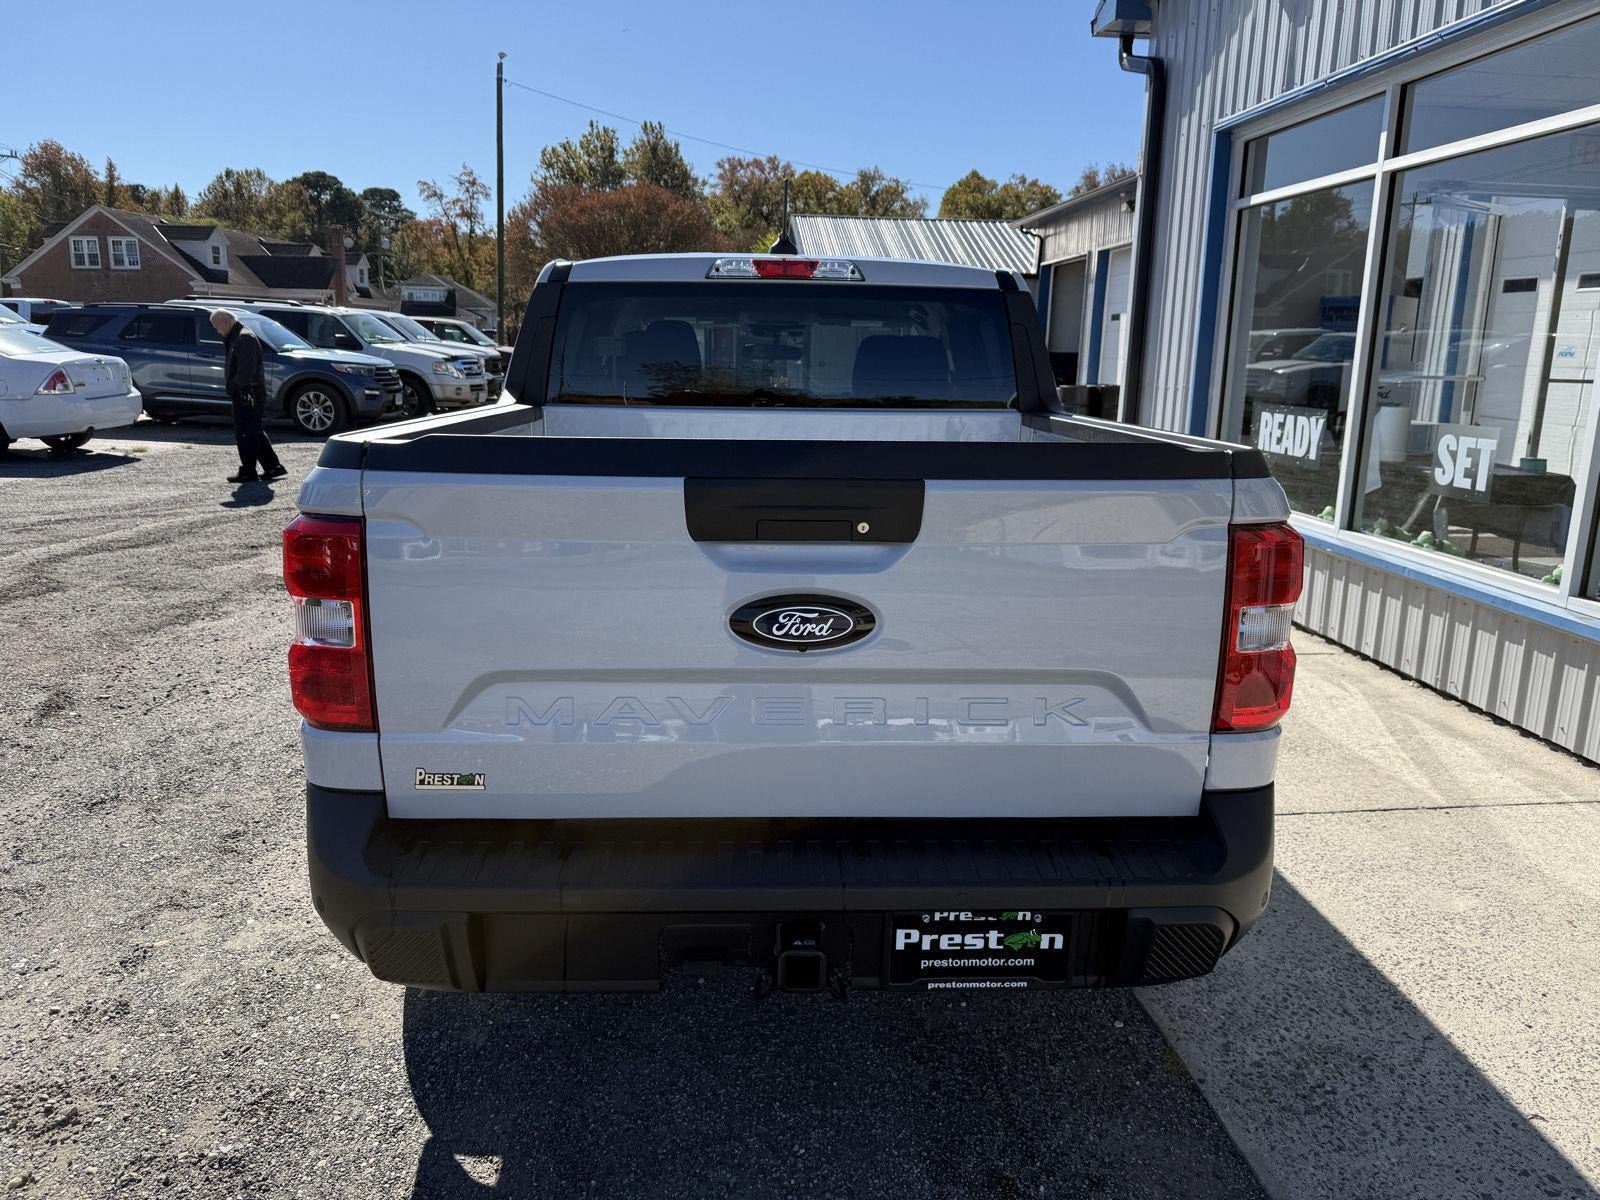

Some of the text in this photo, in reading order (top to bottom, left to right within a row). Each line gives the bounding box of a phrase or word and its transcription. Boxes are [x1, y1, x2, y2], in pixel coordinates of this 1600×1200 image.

[1258, 411, 1326, 460] READY
[1434, 433, 1498, 492] SET
[772, 611, 832, 636] Ford
[505, 696, 1089, 726] MAVERICK
[415, 768, 485, 786] PRESTN
[895, 928, 1064, 951] Prestn
[920, 957, 1035, 969] prestonmotor.com
[927, 980, 1028, 990] prestonmotor.com
